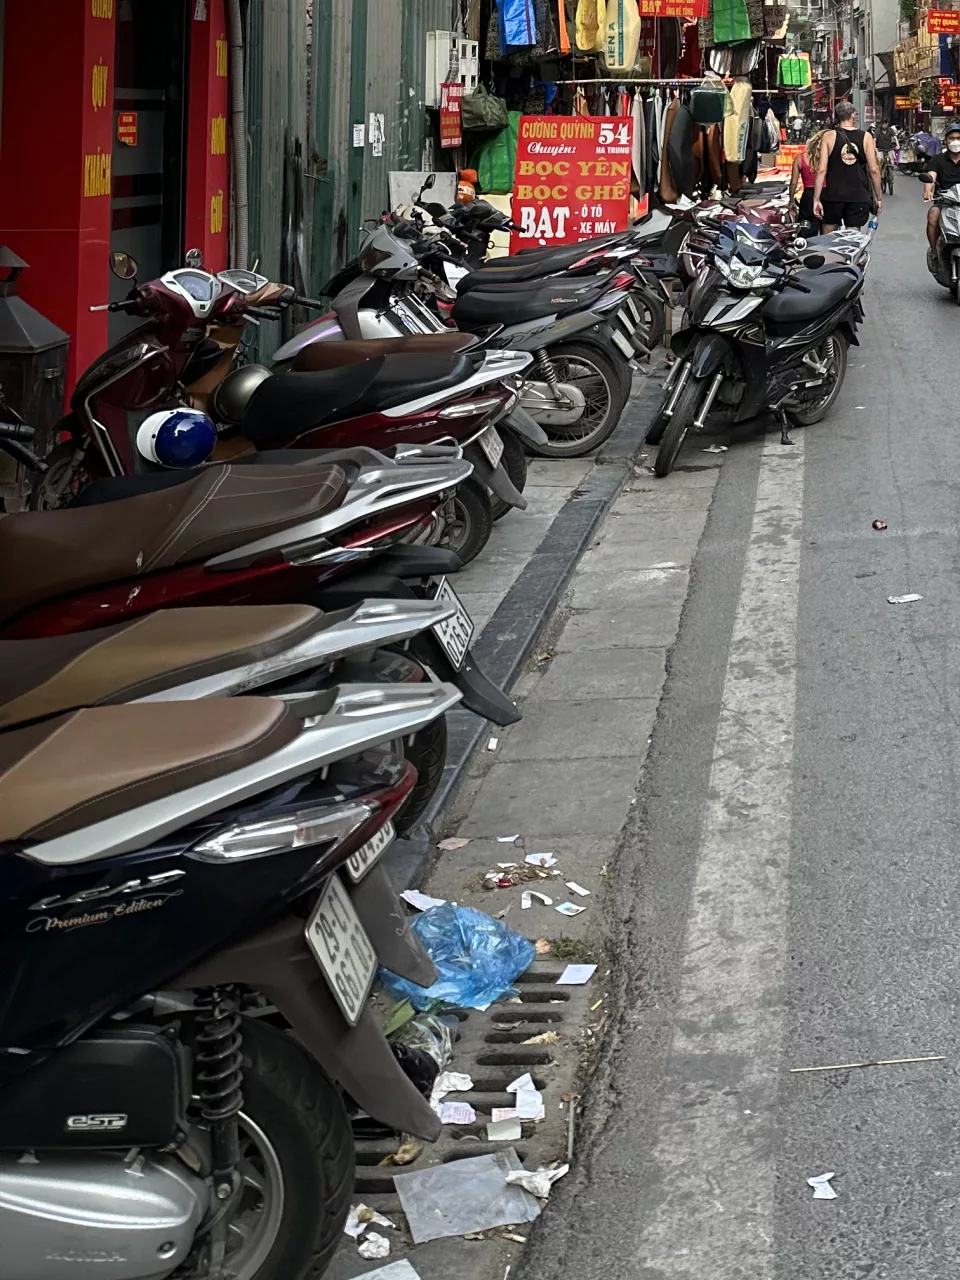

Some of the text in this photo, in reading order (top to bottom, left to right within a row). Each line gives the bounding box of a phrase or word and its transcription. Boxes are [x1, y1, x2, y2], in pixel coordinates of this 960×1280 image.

[522, 118, 631, 145] CƯỜNG QUỲNH 54
[607, 146, 630, 154] TRUNG
[84, 146, 112, 198] KHÁCH
[518, 156, 629, 180] BỌC YÊN
[516, 177, 629, 205] BỌC GHẾ
[581, 203, 603, 218] Ô TÔ
[518, 206, 571, 246] BẠT
[579, 219, 617, 234] XE MÁY
[44, 897, 166, 933] Premium Edition
